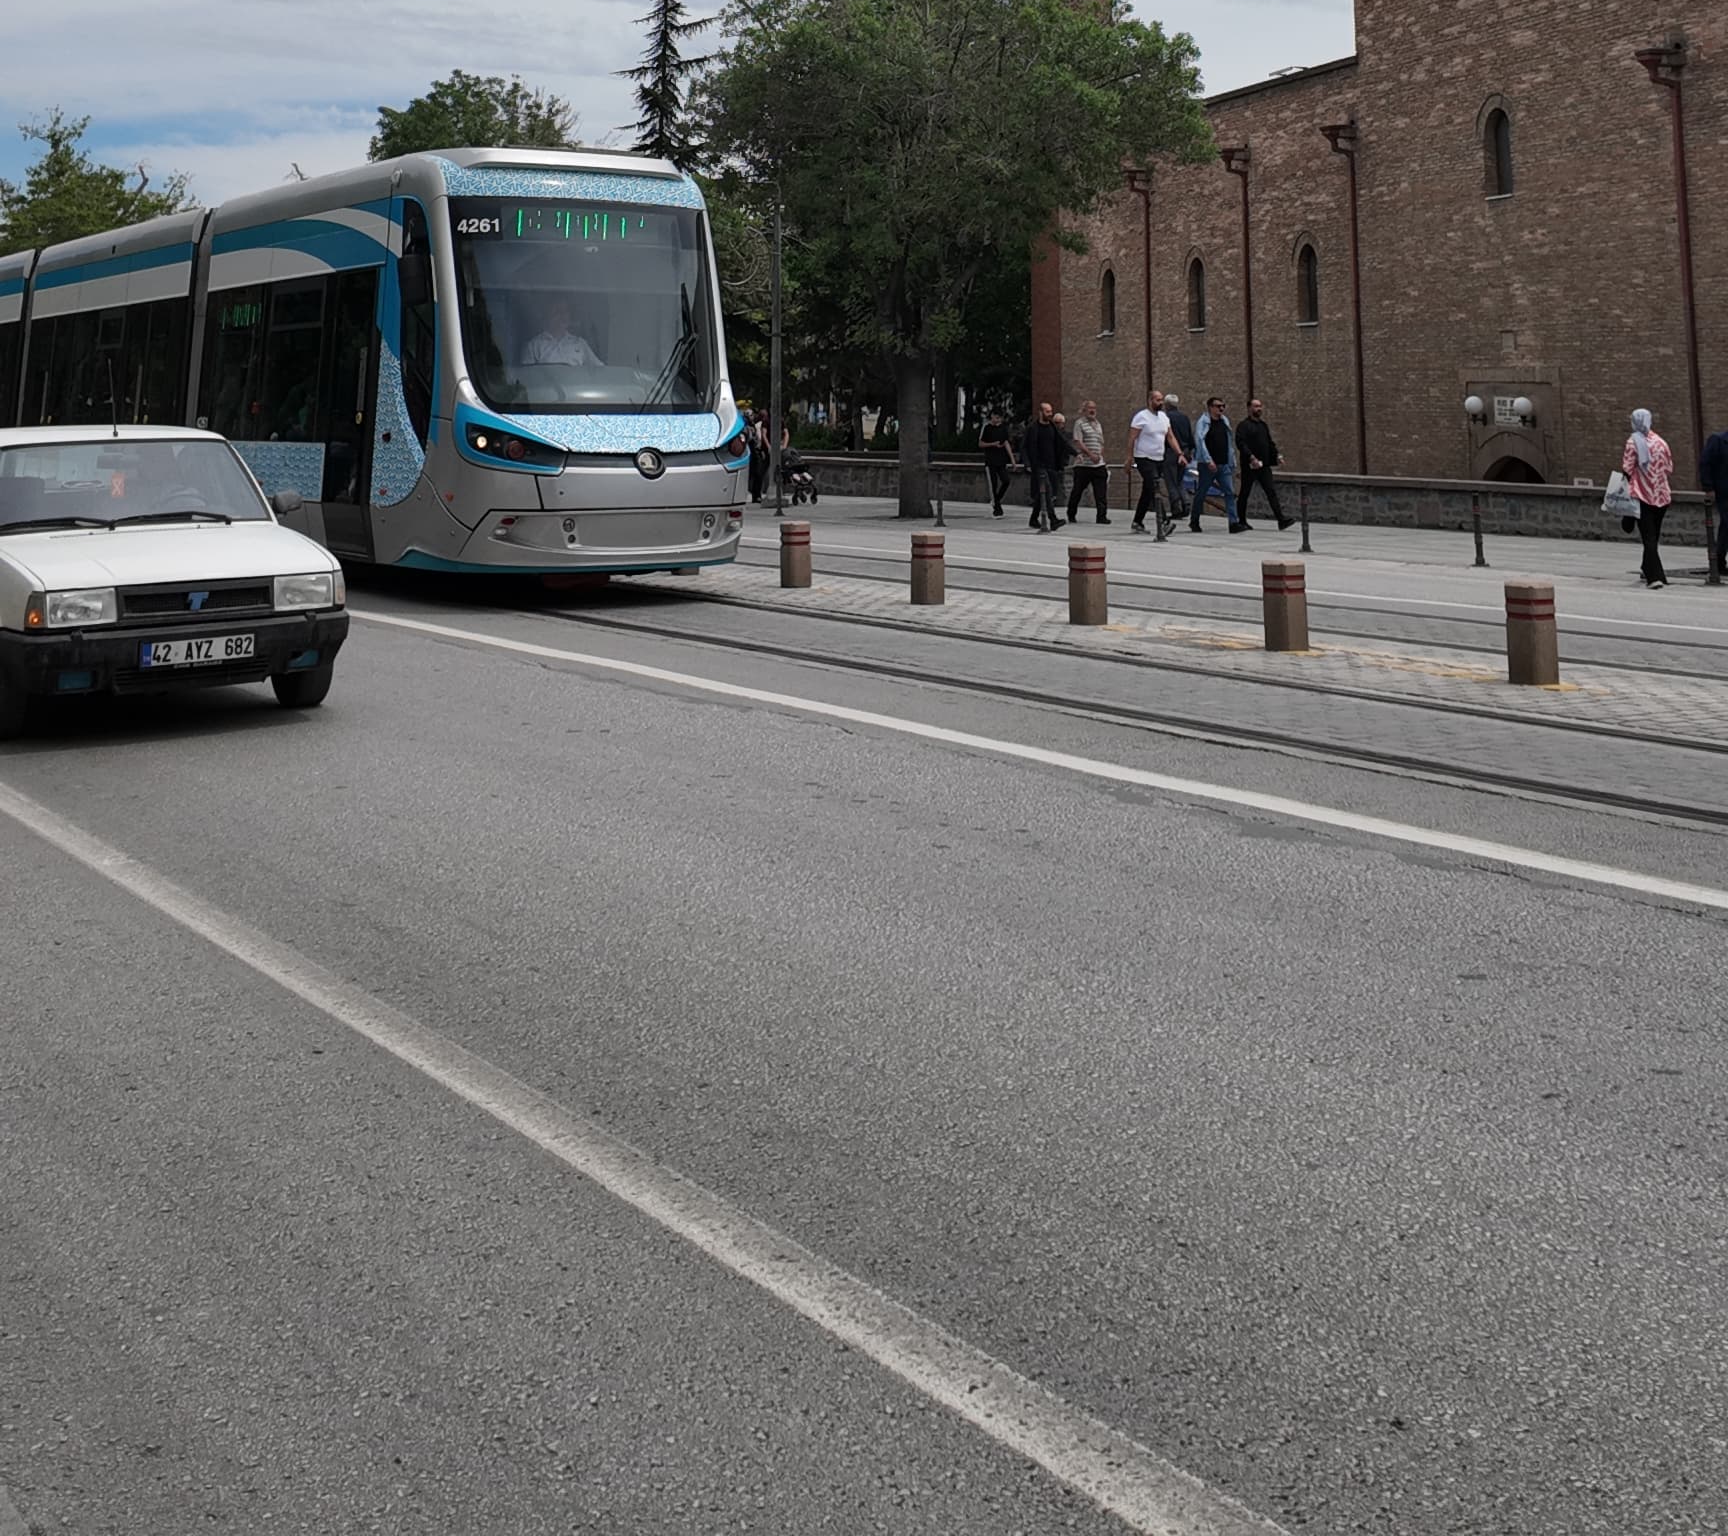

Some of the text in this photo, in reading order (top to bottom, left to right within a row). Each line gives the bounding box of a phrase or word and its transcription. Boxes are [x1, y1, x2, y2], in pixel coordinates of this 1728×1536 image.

[457, 219, 500, 234] 4261
[152, 637, 253, 663] 42 AYZ 682
